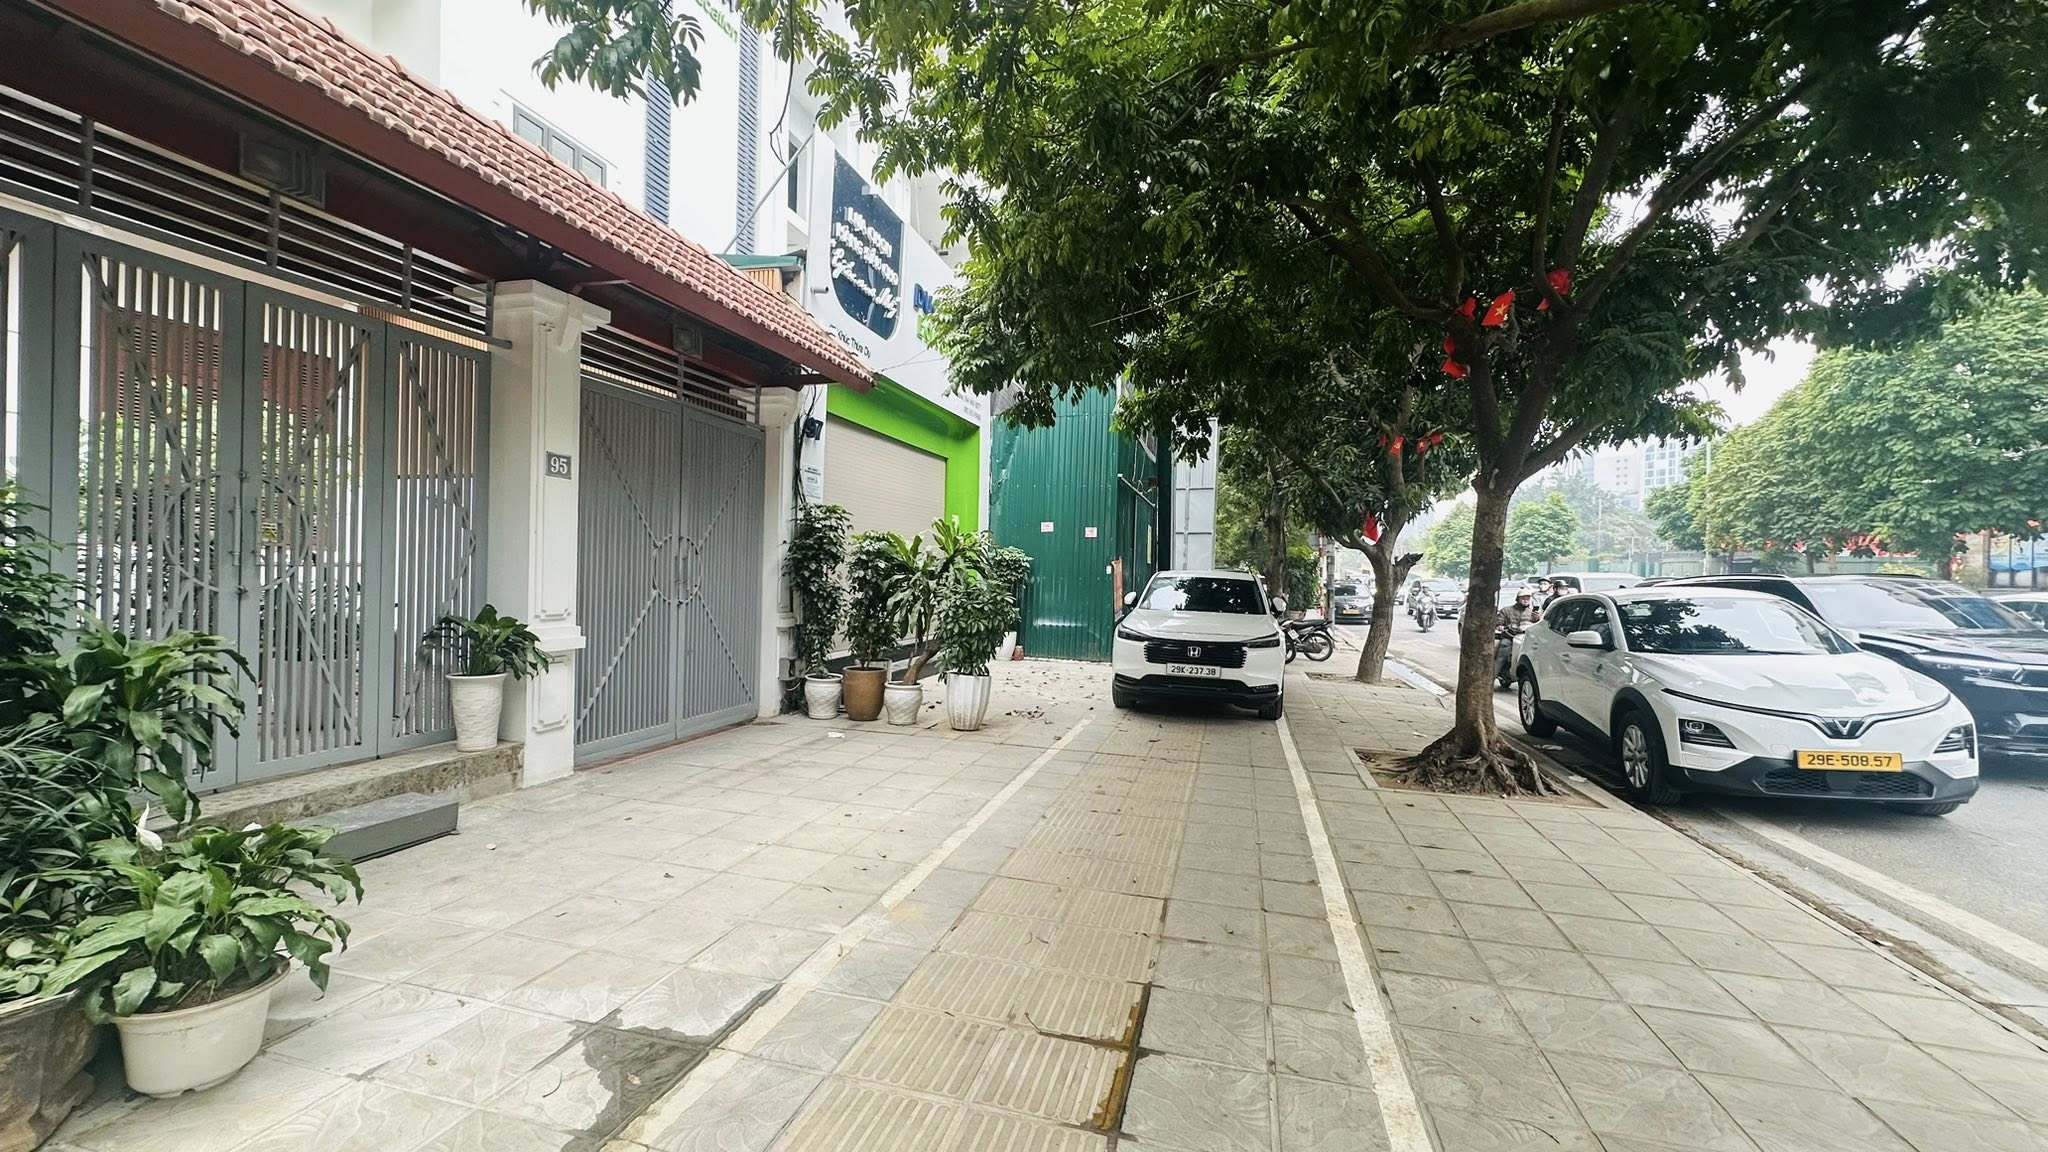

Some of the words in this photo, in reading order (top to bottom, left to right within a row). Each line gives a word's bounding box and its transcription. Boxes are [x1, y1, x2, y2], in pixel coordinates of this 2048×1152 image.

[550, 456, 568, 474] 95
[1171, 664, 1216, 676] 29K-237.38
[1807, 754, 1892, 768] 29E-508.57
